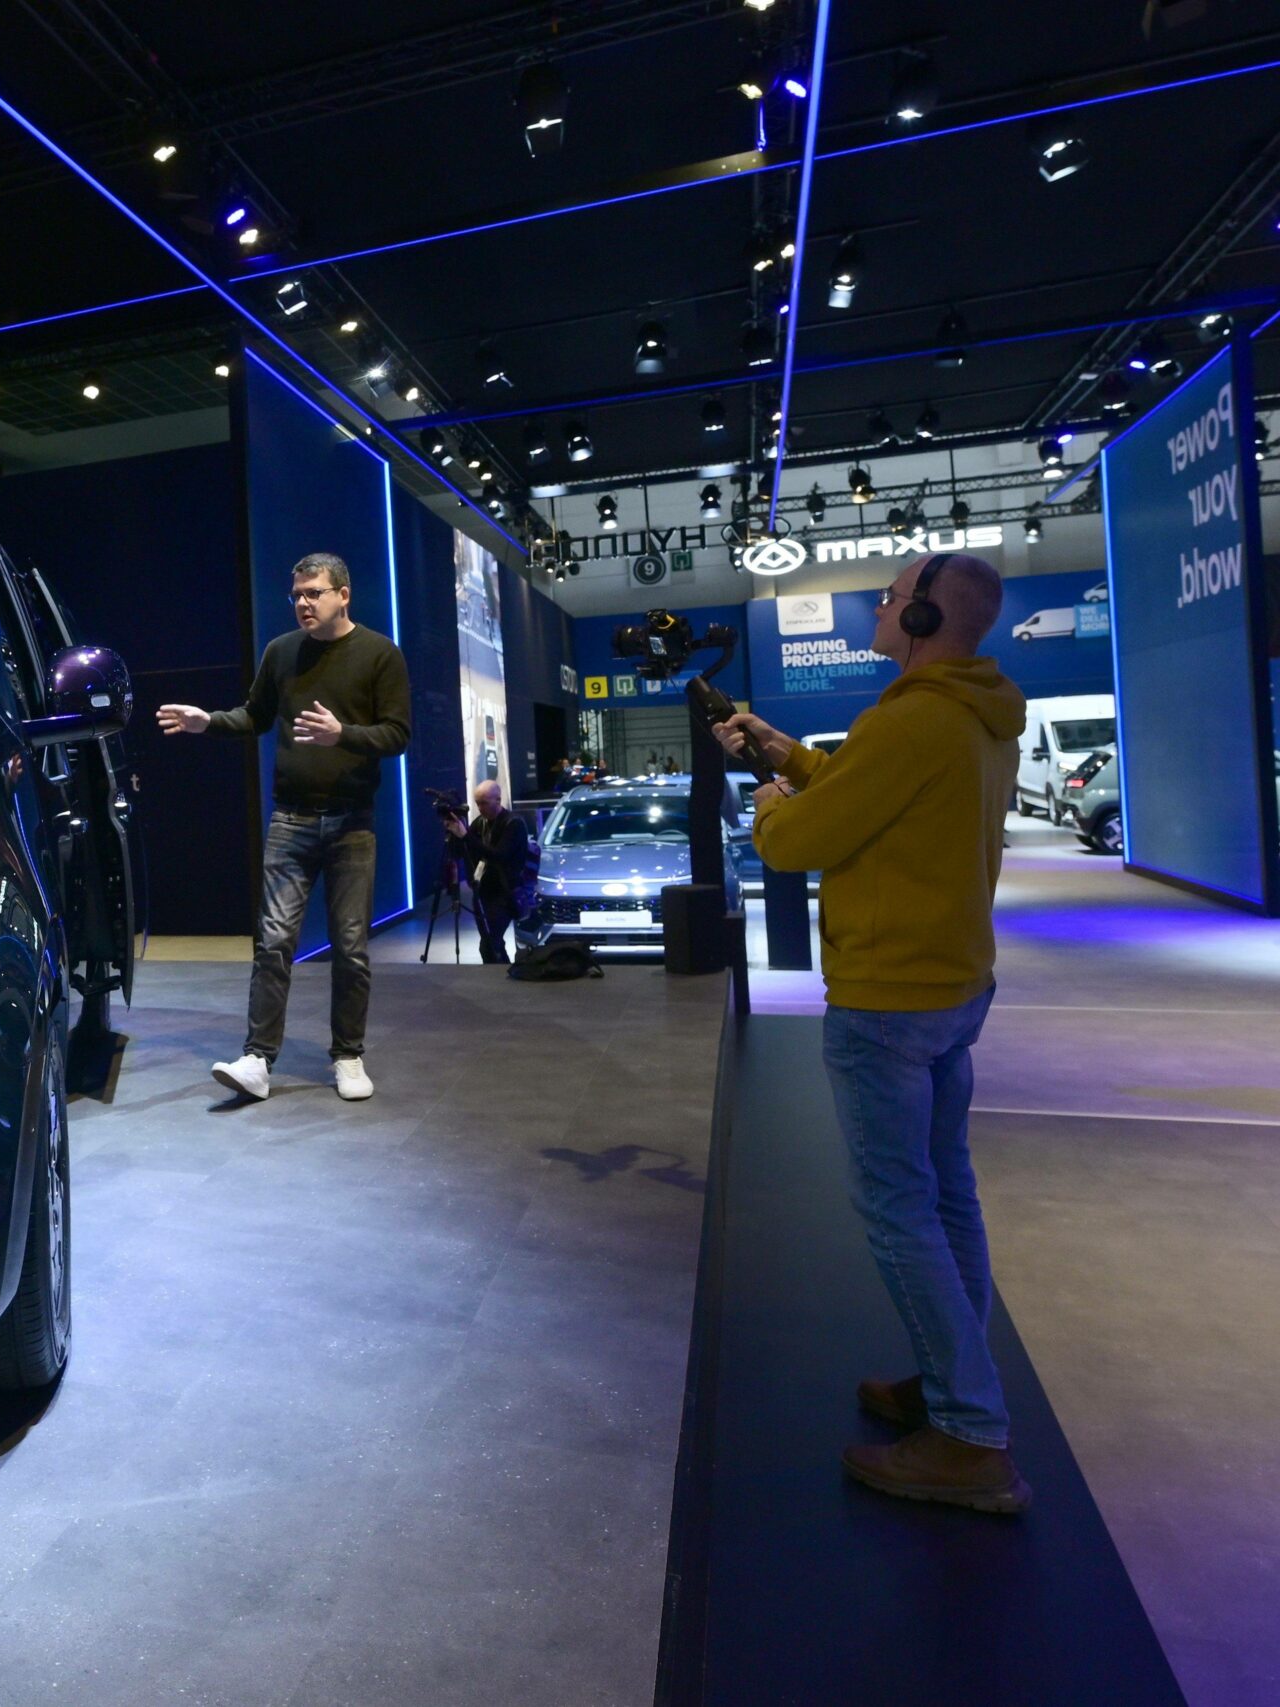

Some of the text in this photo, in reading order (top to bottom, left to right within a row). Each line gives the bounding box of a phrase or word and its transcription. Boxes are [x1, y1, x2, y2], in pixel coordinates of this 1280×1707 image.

[816, 526, 1003, 563] MAXUS
[644, 561, 656, 576] 9
[781, 639, 847, 656] DRIVING
[783, 663, 876, 681] DELIVERING
[590, 681, 602, 695] 9
[784, 679, 835, 693] MORE.
